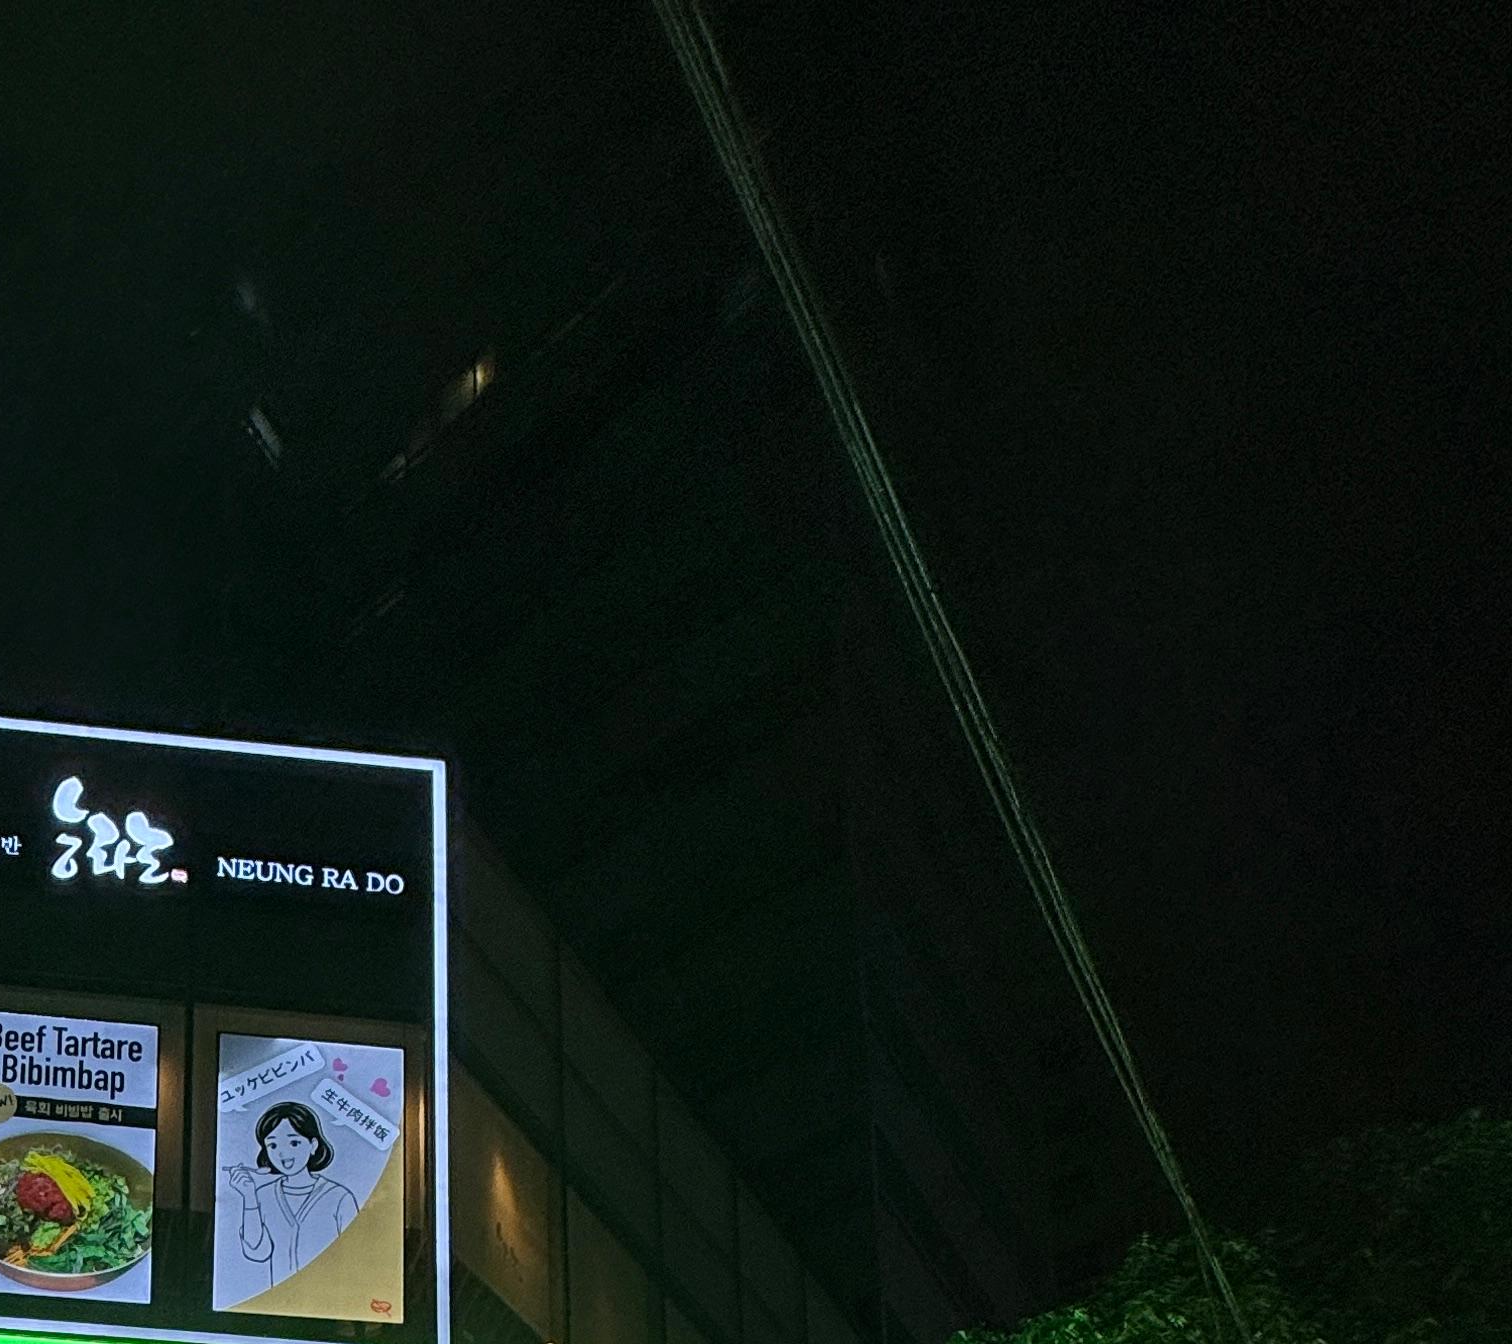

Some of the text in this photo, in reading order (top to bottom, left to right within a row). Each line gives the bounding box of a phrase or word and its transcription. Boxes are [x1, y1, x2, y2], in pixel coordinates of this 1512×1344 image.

[217, 856, 405, 895] NEUNG RA DO
[52, 1026, 143, 1062] Tartare
[1, 1054, 125, 1100] Bibimbap
[220, 1050, 316, 1103] ユッケビビンバ
[24, 1100, 123, 1122] 육회 비빔밥 출시
[321, 1087, 391, 1143] 生牛肉拌饭
